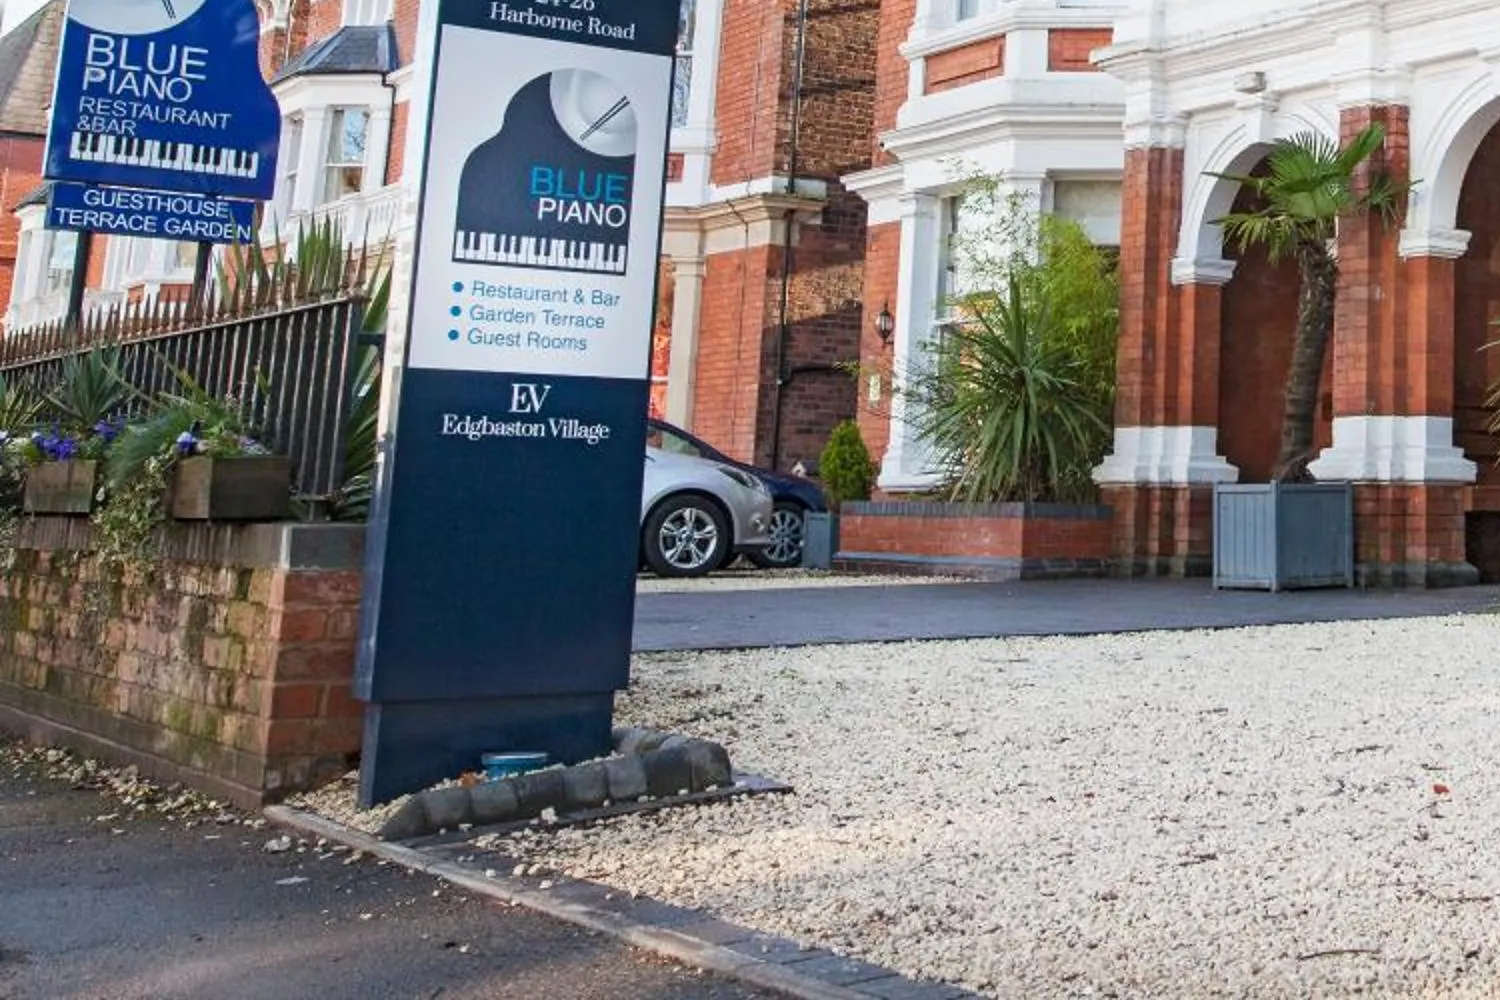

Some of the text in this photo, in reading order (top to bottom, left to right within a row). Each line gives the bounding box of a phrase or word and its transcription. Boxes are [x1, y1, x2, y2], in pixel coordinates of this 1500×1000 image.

[489, 1, 636, 41] Harborne Road
[86, 33, 209, 80] BLUE
[81, 66, 193, 103] PIANO
[76, 115, 138, 137] &BAR
[79, 96, 232, 130] RESTAURANT
[530, 166, 628, 203] BLUE
[83, 189, 230, 219] GUESTHOUSE
[537, 197, 627, 227] PIANO
[55, 207, 251, 241] TERRACE GARDEN
[471, 280, 621, 307] Restaurant & Bar
[469, 304, 605, 329] Garden Terrace
[467, 328, 588, 351] Guest Rooms
[509, 383, 552, 414] EV
[442, 414, 610, 445] Edgbaston Village
